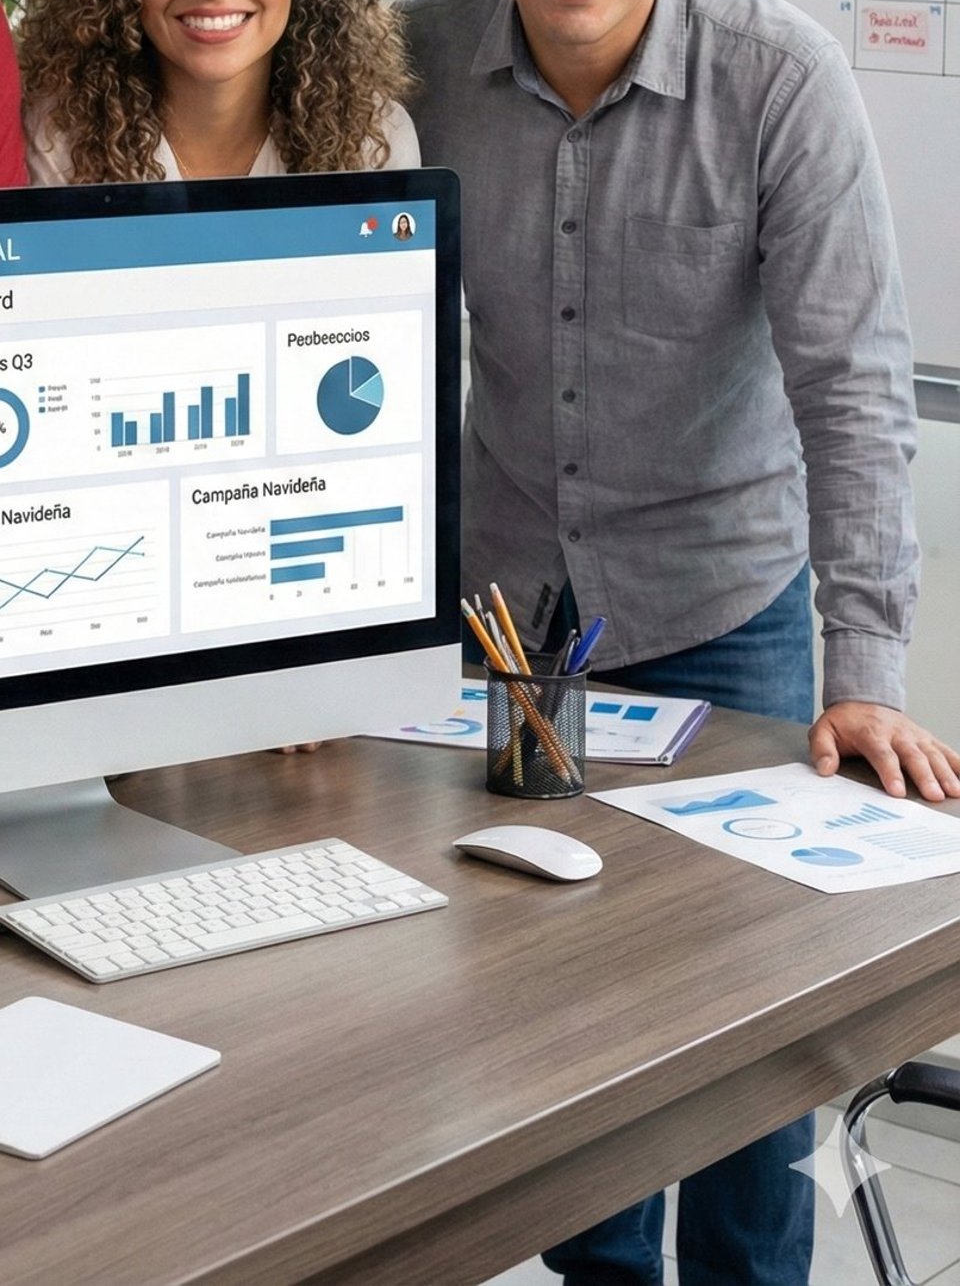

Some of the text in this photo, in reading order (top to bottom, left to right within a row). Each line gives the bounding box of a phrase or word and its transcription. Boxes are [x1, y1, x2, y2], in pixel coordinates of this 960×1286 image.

[12, 353, 34, 372] Q3
[191, 476, 327, 505] Campaña Navideña
[1, 503, 72, 526] Navideña
